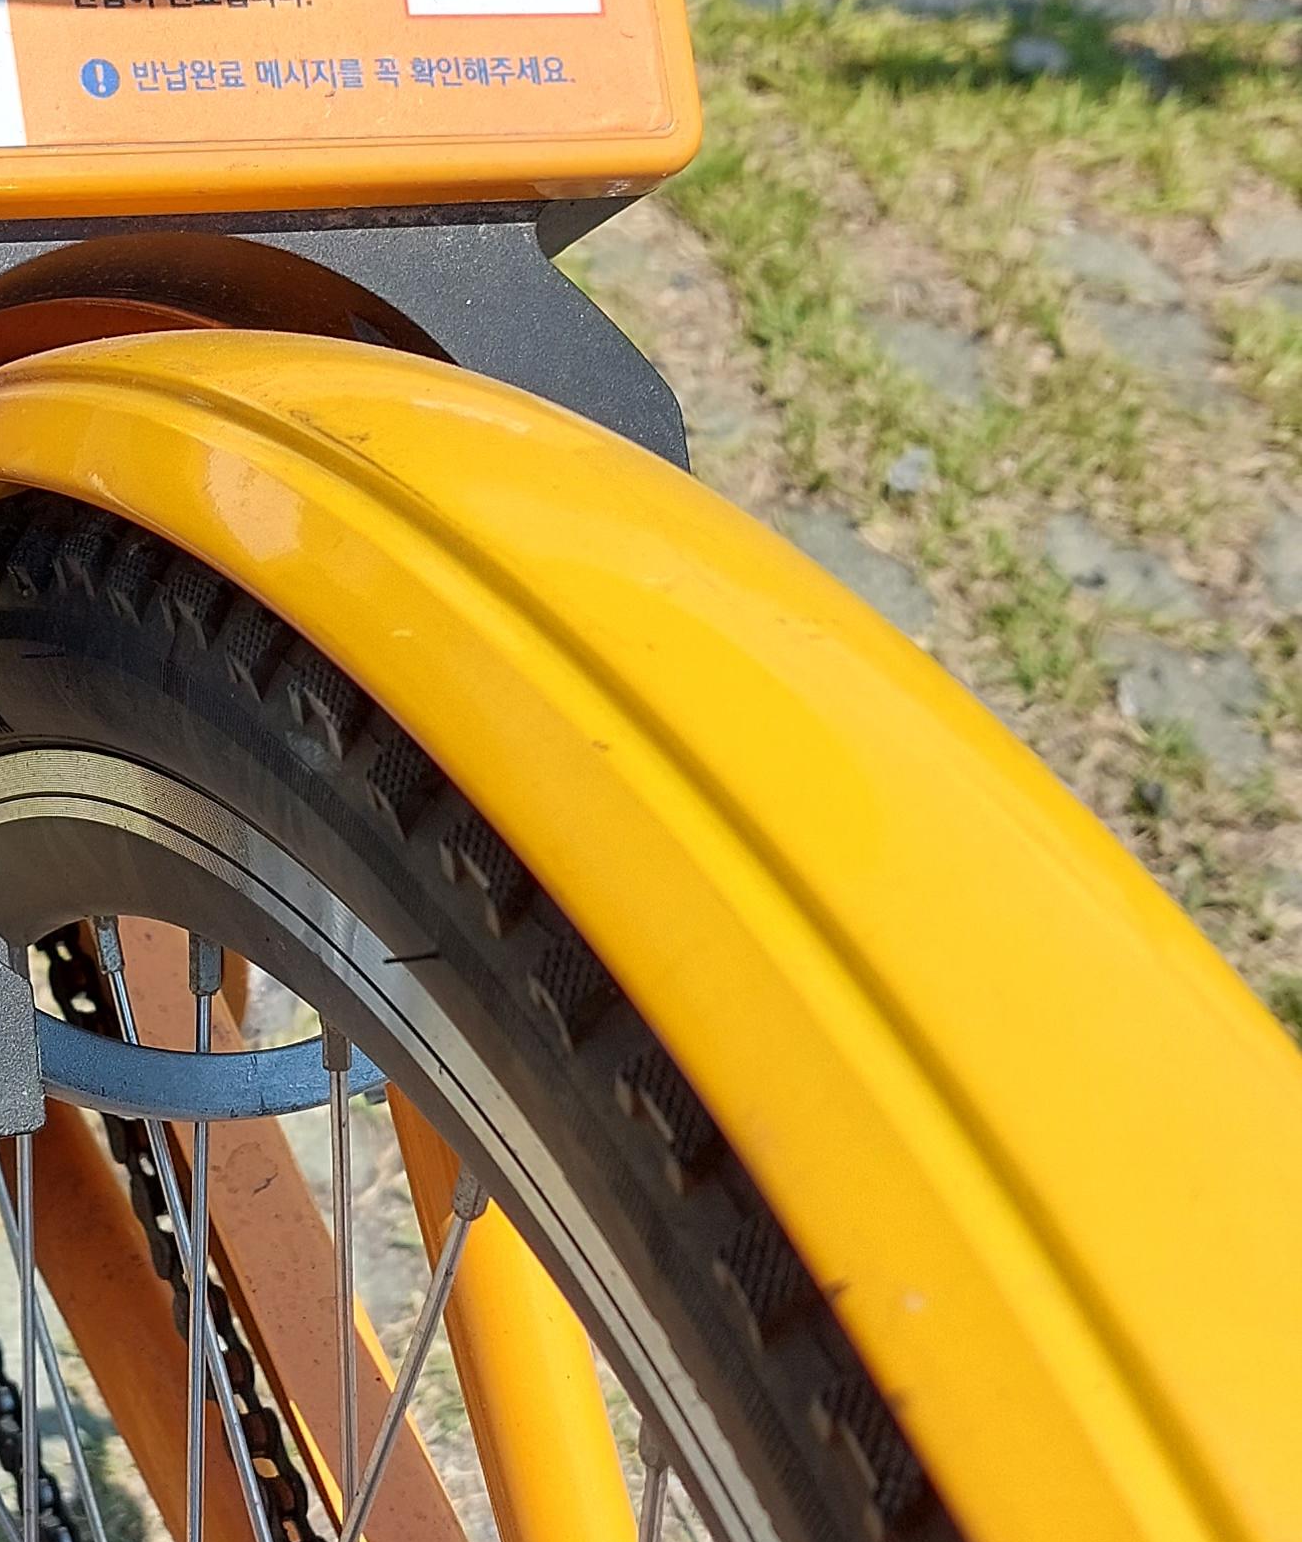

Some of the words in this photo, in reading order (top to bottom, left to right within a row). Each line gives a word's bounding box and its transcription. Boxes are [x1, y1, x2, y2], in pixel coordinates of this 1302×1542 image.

[131, 59, 246, 92] 반납완료
[254, 57, 365, 90] 메시지를
[373, 57, 401, 87] 꼭
[409, 56, 577, 88] 확인해주세요.
